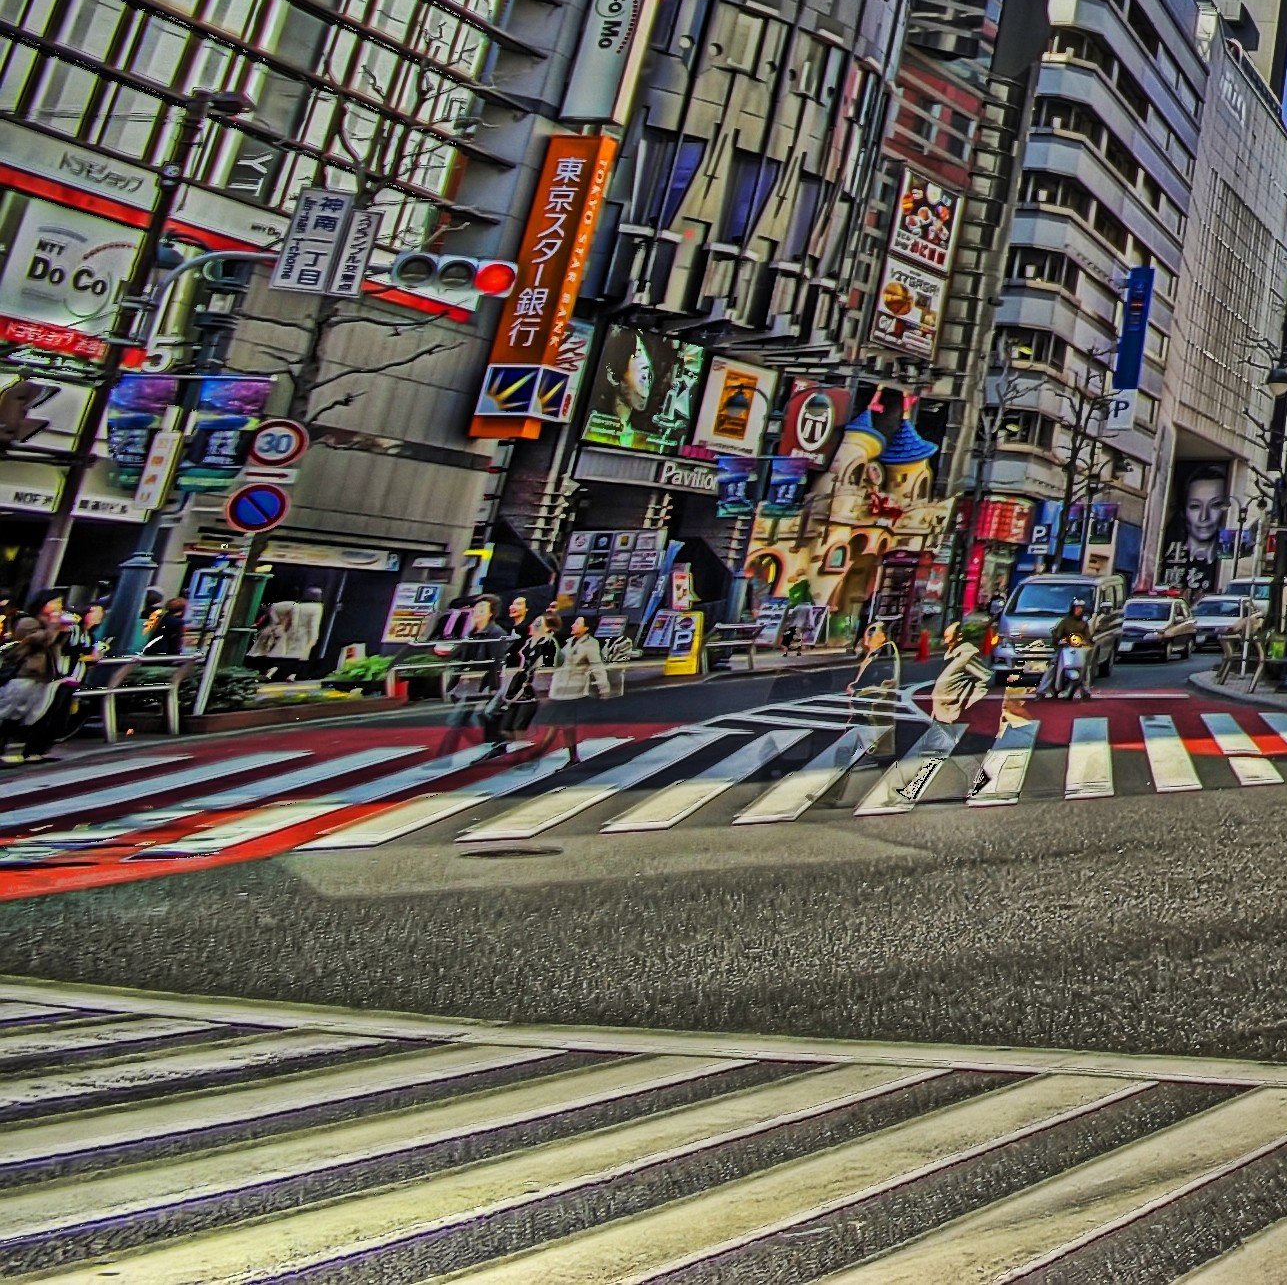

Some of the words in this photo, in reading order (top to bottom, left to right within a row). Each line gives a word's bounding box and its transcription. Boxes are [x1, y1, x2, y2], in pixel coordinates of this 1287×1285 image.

[582, 159, 608, 226] TOKYO
[35, 236, 67, 257] NTT
[297, 196, 345, 286] 神南一丁目
[509, 156, 588, 348] 東京スター銀行
[566, 231, 588, 283] STAR
[1114, 400, 1130, 418] P
[257, 433, 294, 455] 30
[660, 463, 718, 491] Pavilio
[423, 587, 434, 603] P
